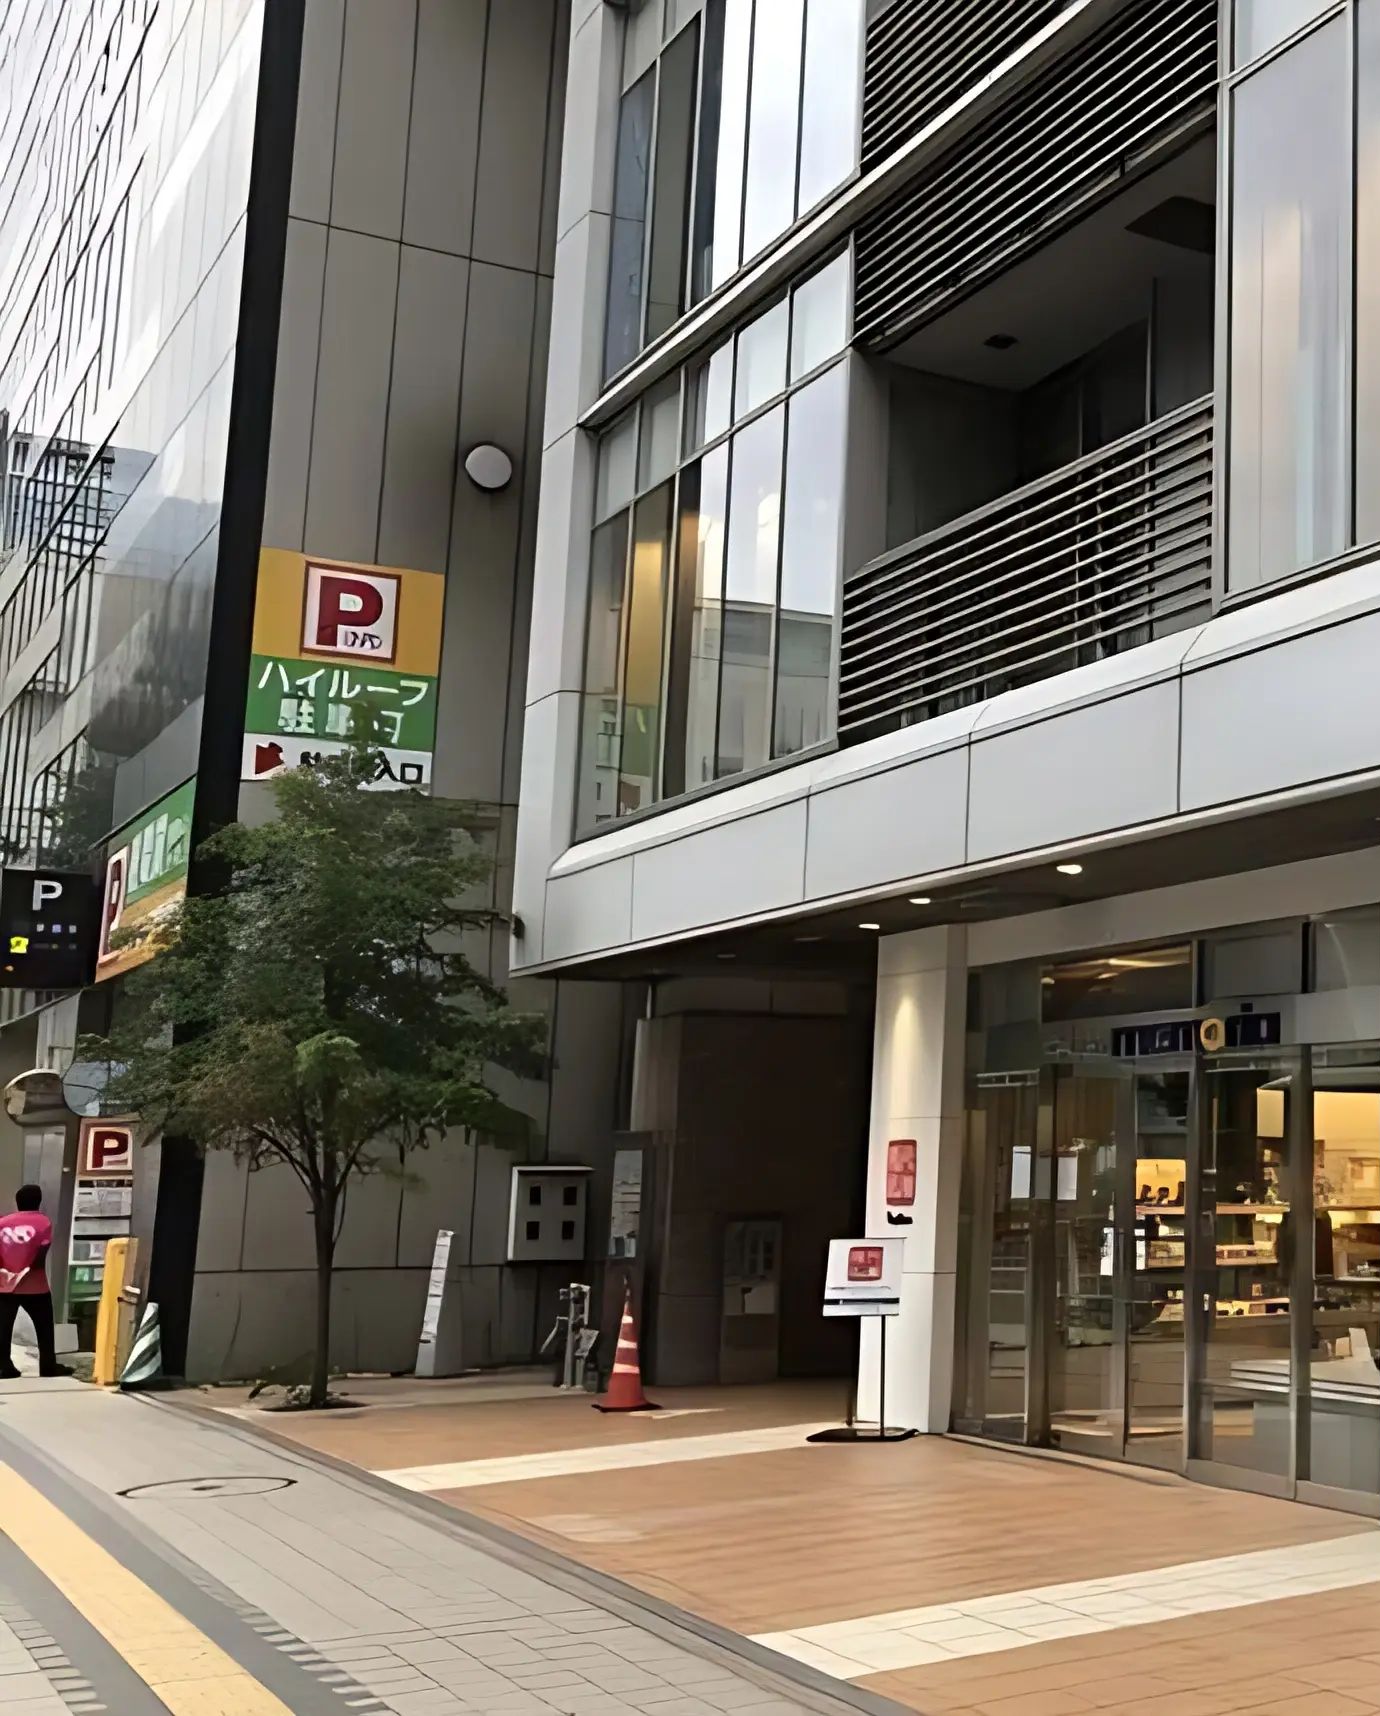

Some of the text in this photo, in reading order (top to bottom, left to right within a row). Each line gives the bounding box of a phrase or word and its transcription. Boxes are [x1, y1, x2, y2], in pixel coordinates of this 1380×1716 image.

[316, 575, 383, 647] P
[32, 879, 63, 911] P
[91, 1130, 129, 1169] P
